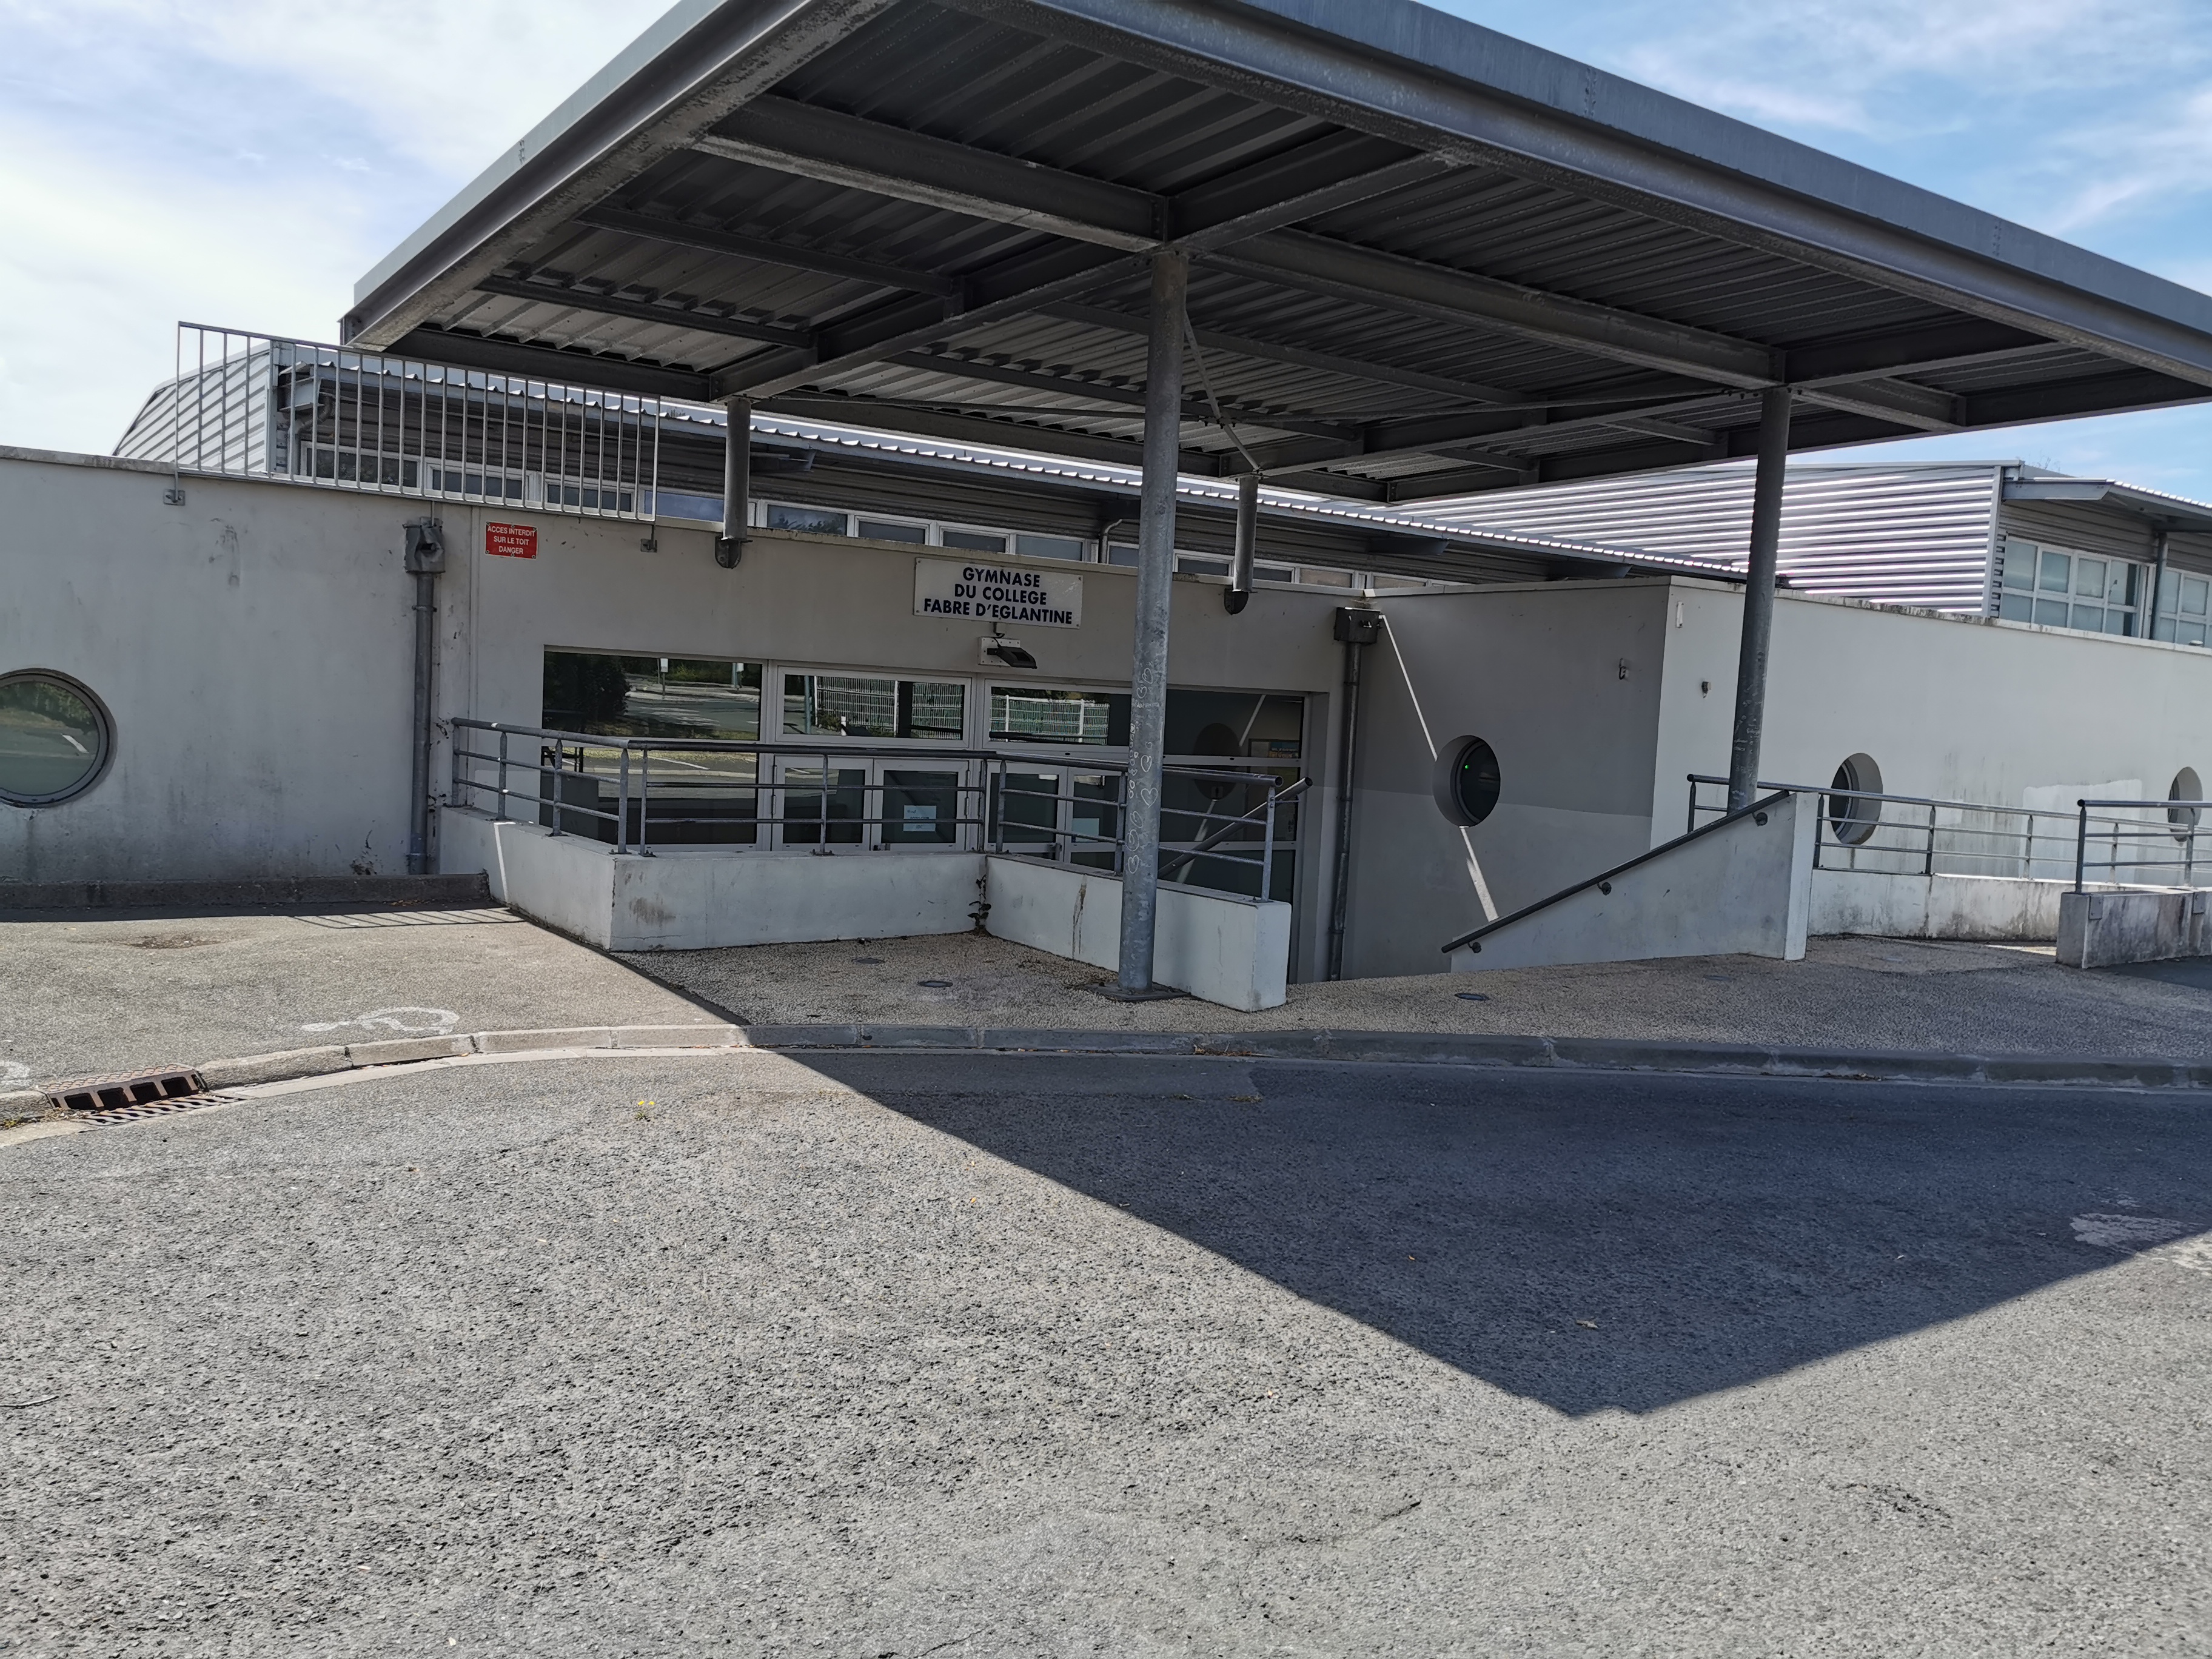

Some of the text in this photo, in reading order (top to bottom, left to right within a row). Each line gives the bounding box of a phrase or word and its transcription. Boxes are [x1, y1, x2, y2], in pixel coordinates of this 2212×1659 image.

[488, 526, 535, 537] ACCES INTERDIT
[498, 546, 524, 554] DANGER
[963, 567, 1041, 588] GYMNASE
[954, 584, 1047, 605] DU COLLEGE
[923, 598, 1073, 625] FABRE D'EGLANTINE
